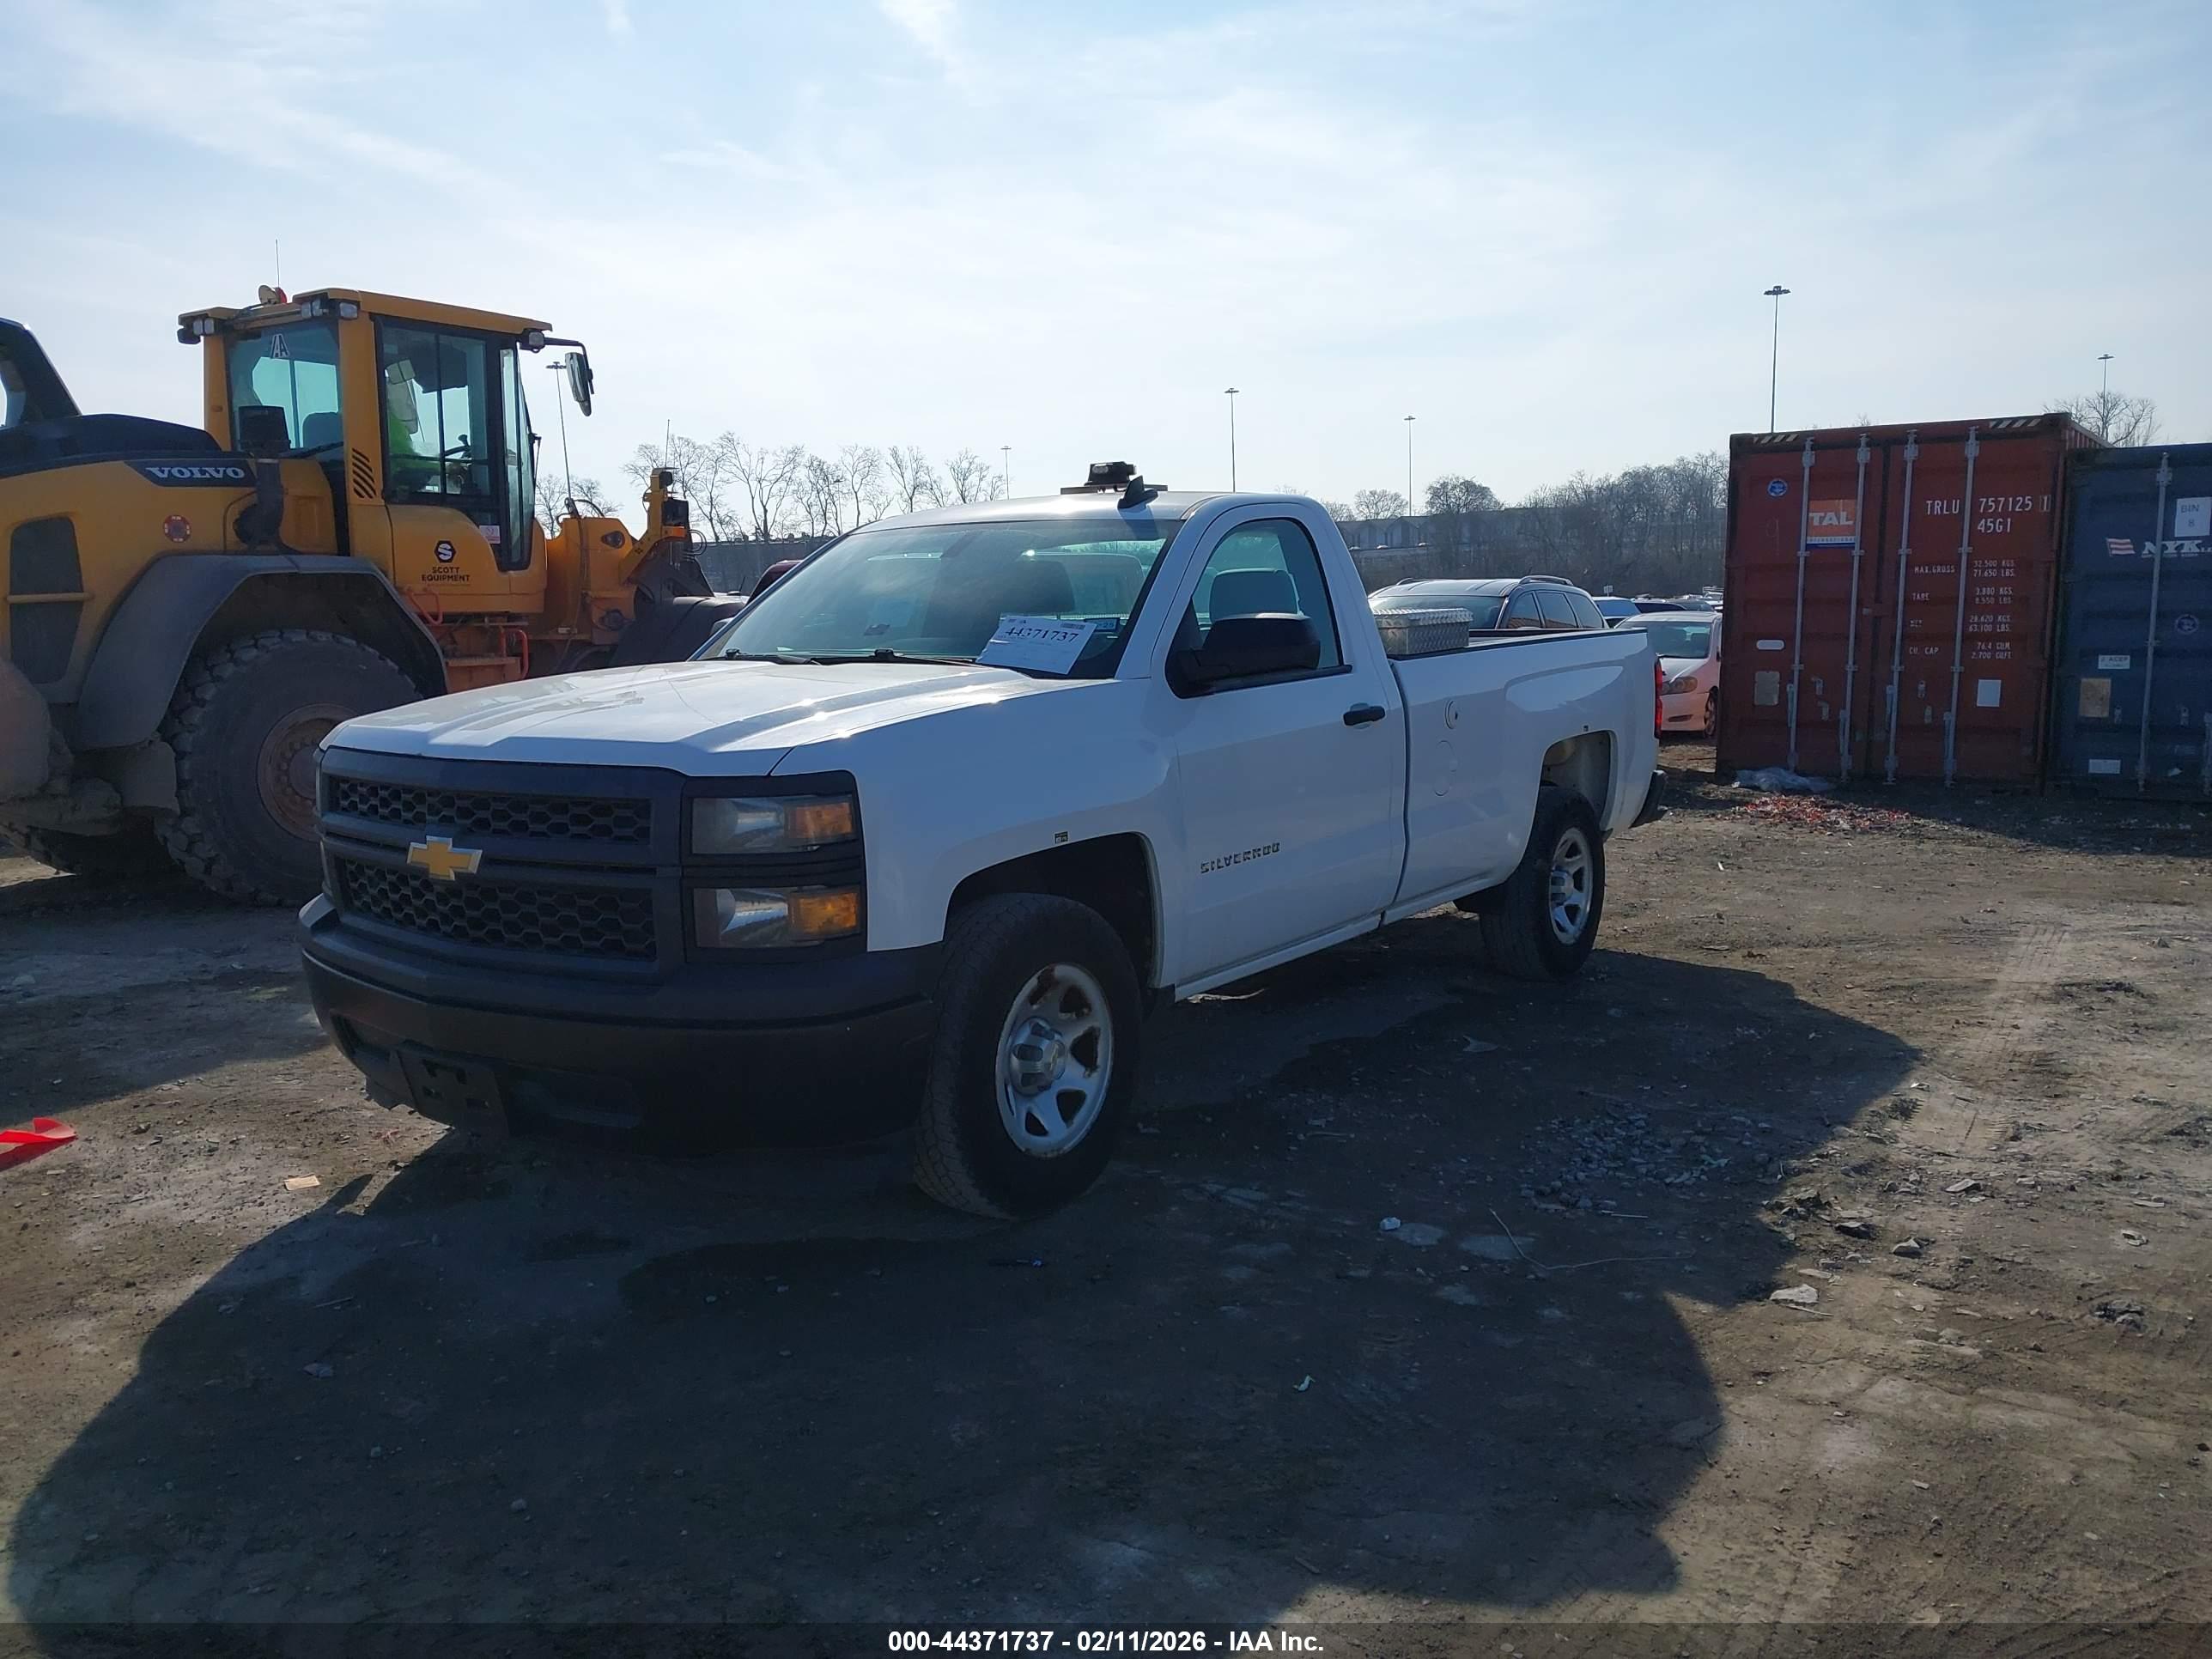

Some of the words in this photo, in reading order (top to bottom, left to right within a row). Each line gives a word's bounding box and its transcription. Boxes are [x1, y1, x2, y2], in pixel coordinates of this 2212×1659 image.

[145, 467, 245, 478] VOLVO
[1926, 500, 1960, 515] TRLU
[1979, 496, 2033, 513] 757125
[2181, 504, 2200, 513] BIN
[1809, 512, 1854, 526] TAL
[1006, 627, 1079, 642] 44371737
[1200, 842, 1280, 874] SILVERADO
